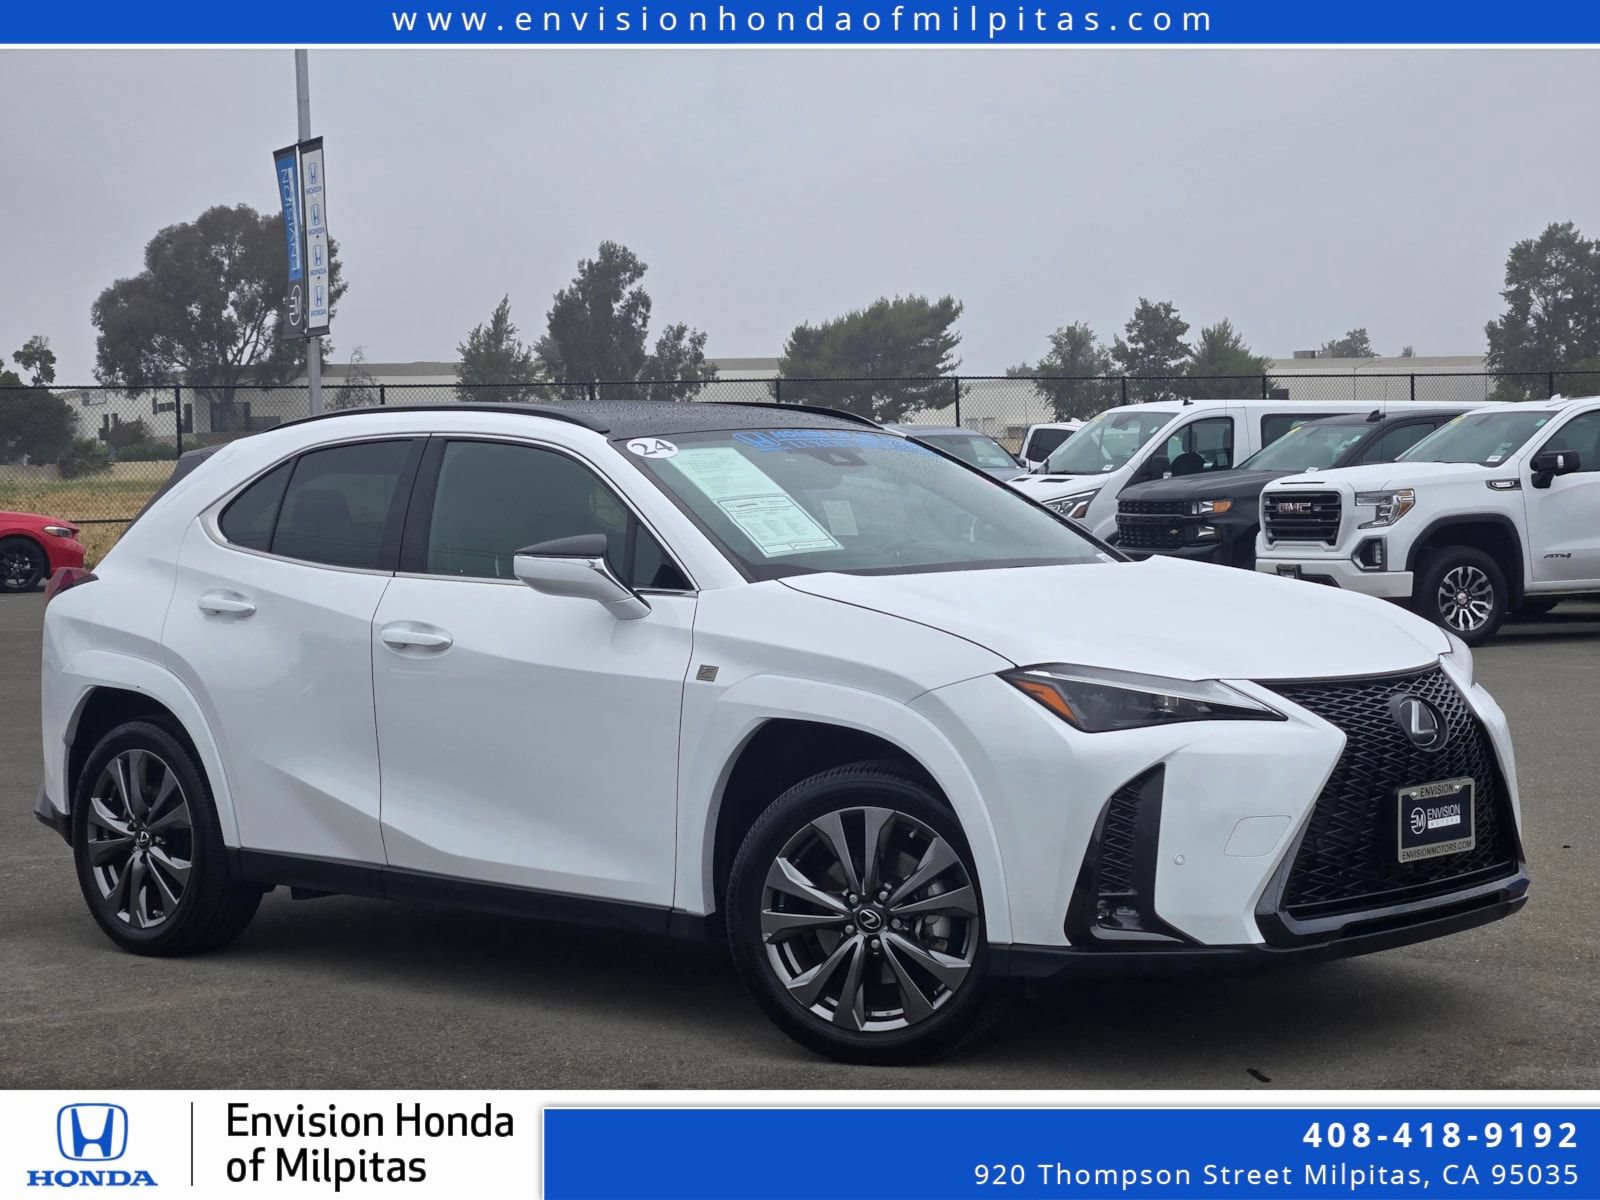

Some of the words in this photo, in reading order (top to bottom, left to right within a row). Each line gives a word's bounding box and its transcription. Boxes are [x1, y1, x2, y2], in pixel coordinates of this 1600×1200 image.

[306, 186, 322, 195] HONDA
[308, 226, 325, 236] HONDA
[310, 268, 327, 277] HONDA
[310, 308, 327, 317] HONDA
[639, 440, 674, 456] 24
[1277, 502, 1312, 514] GMC
[1420, 783, 1454, 798] ENVISION
[1427, 803, 1461, 820] ENVISION
[1402, 838, 1472, 860] ENVISIONMOTORS.COM
